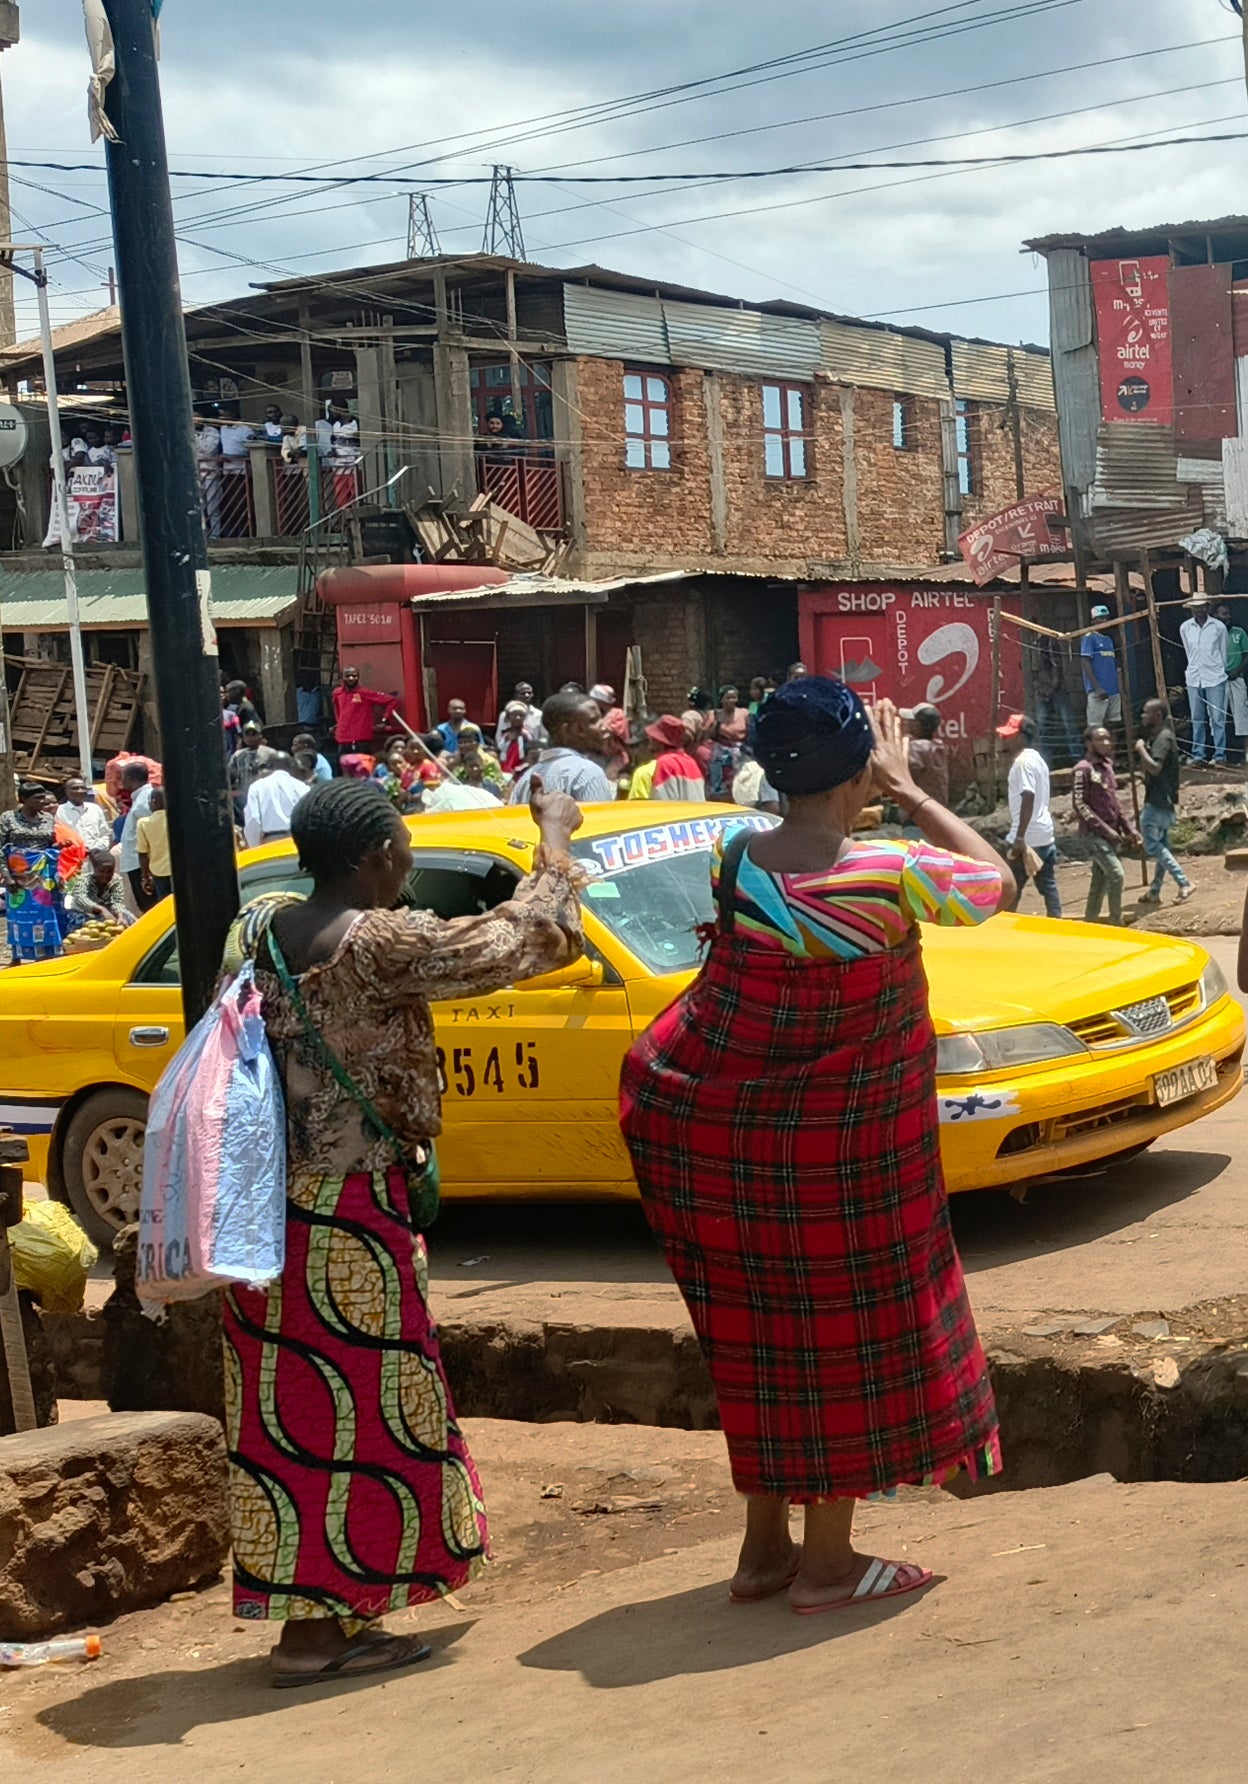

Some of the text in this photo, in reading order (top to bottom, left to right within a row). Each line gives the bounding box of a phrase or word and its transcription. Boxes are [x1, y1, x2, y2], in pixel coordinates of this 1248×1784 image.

[1116, 343, 1150, 359] airtel
[838, 591, 975, 612] SHOP AIRTEL
[896, 610, 907, 675] DEPOT
[452, 1004, 515, 1022] TAXI
